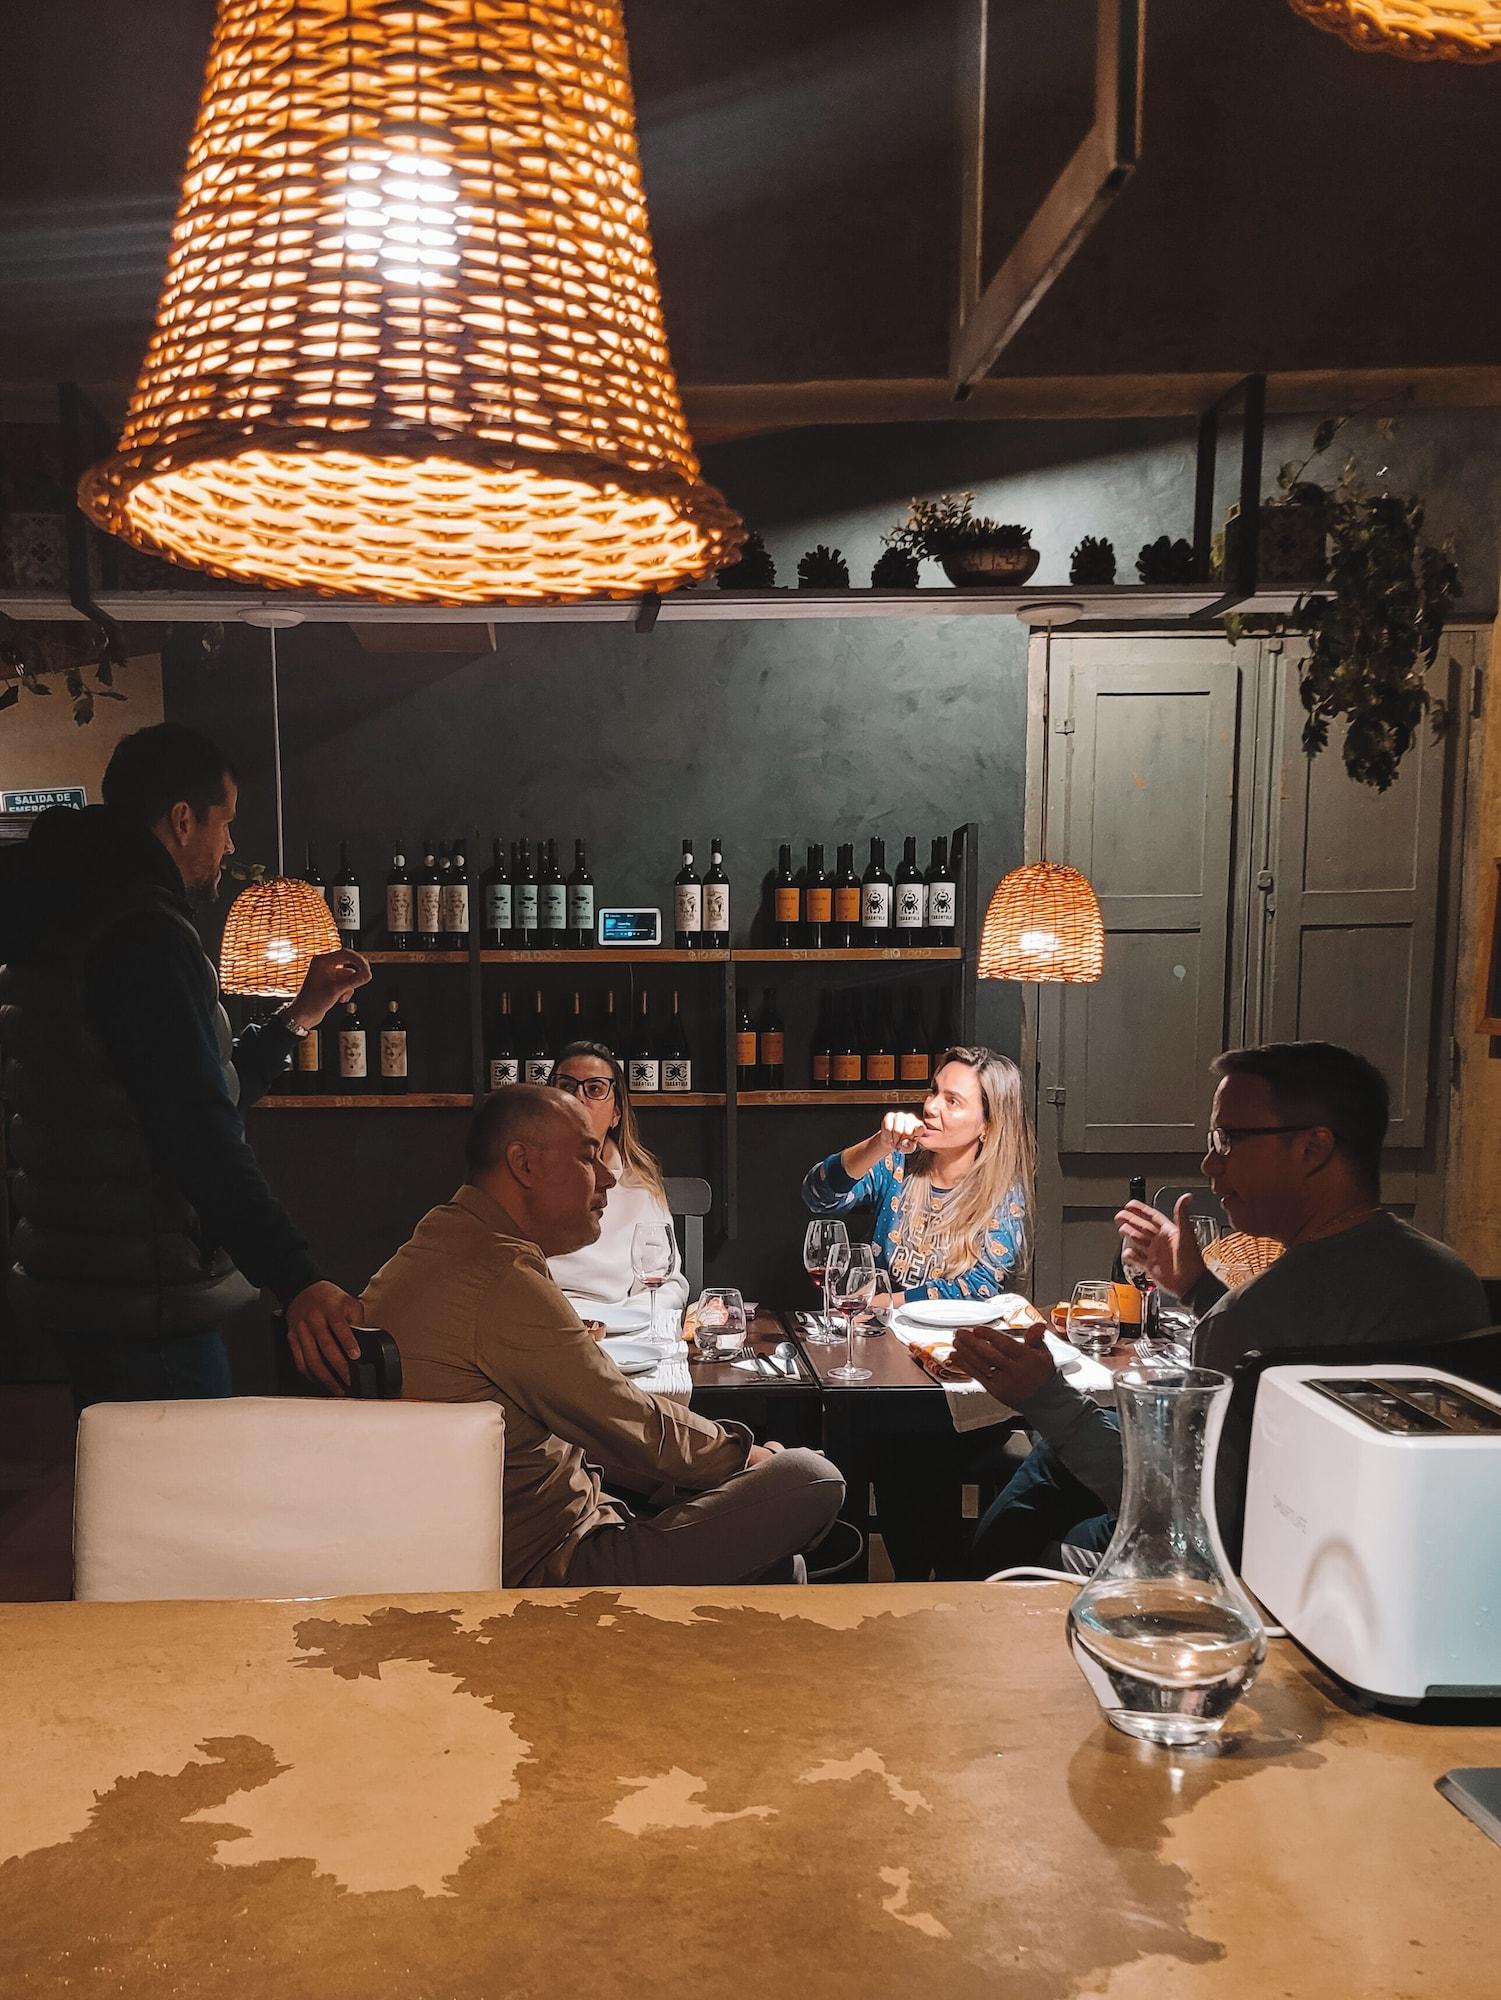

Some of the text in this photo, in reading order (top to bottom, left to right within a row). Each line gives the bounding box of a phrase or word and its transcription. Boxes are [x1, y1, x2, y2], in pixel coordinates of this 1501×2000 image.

[15, 792, 71, 804] SALIDA DE
[8, 803, 80, 812] EMERGA
